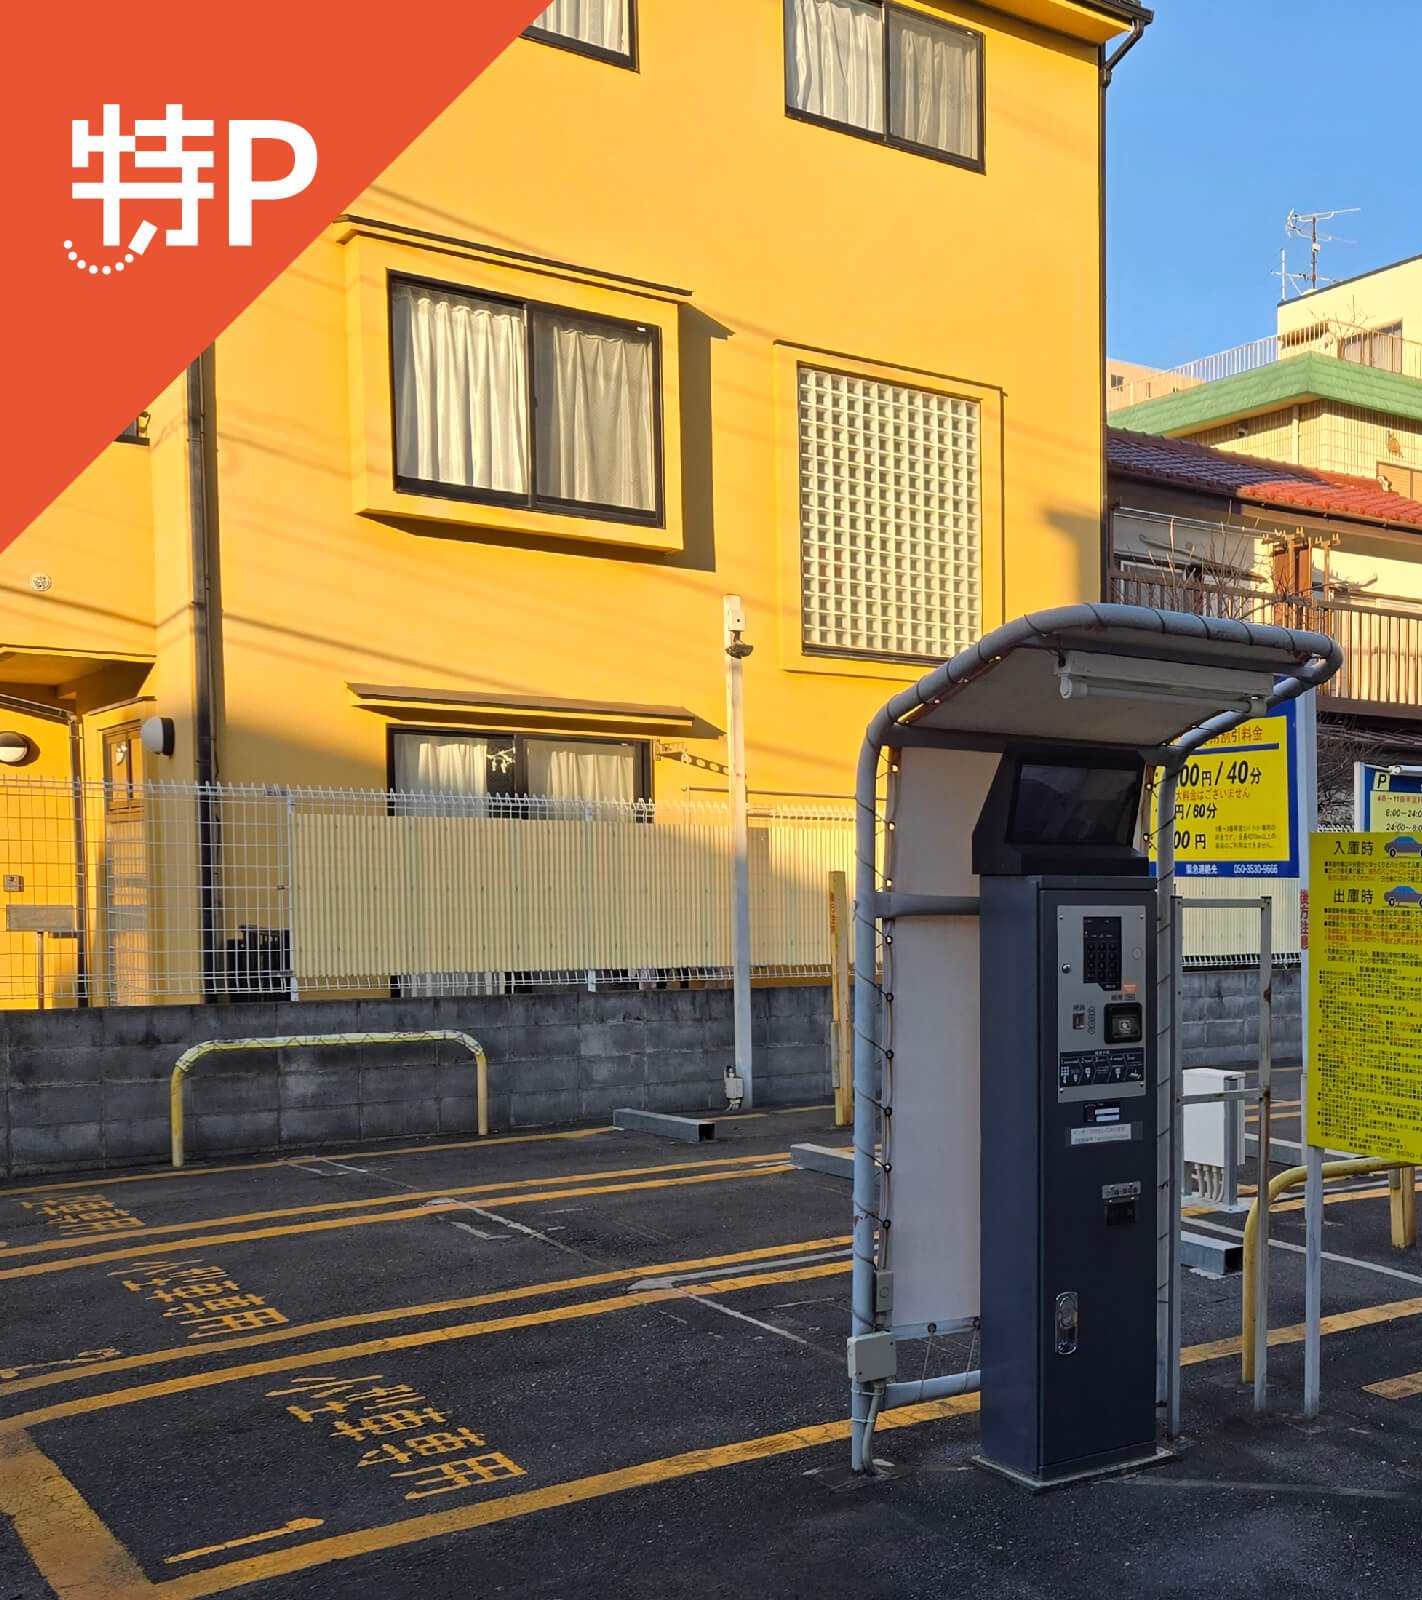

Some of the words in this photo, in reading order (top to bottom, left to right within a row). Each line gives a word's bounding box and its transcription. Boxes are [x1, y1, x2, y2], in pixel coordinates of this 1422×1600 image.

[1176, 788, 1250, 801] 大料金はございません
[1333, 840, 1374, 856] 入庫時
[1333, 888, 1374, 904] 出庫時
